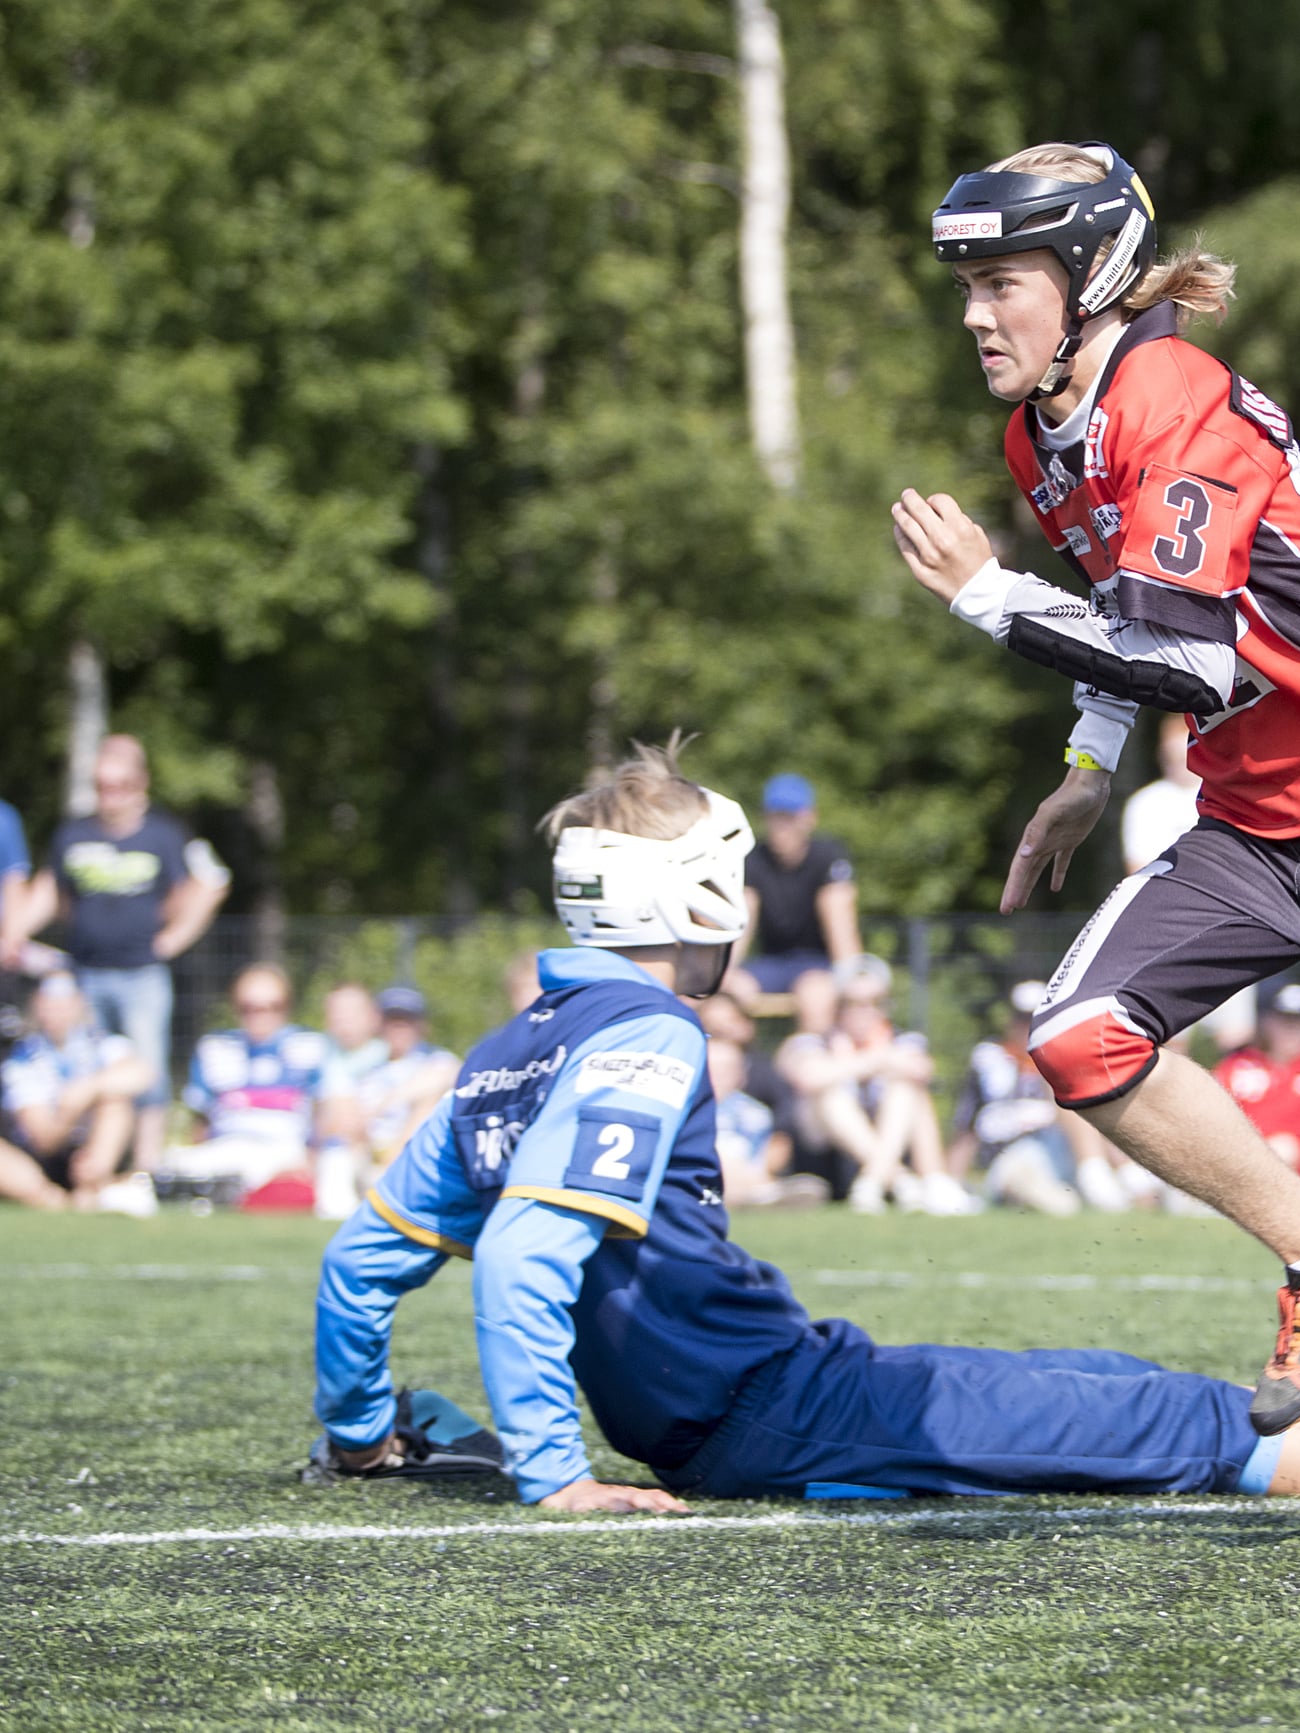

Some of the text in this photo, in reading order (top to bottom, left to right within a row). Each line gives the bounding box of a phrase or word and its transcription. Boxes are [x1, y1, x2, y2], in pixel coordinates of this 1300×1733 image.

[980, 222, 998, 234] OY
[1085, 213, 1144, 307] www.mittamatti.com
[1151, 477, 1212, 579] 3
[591, 1122, 635, 1180] 2
